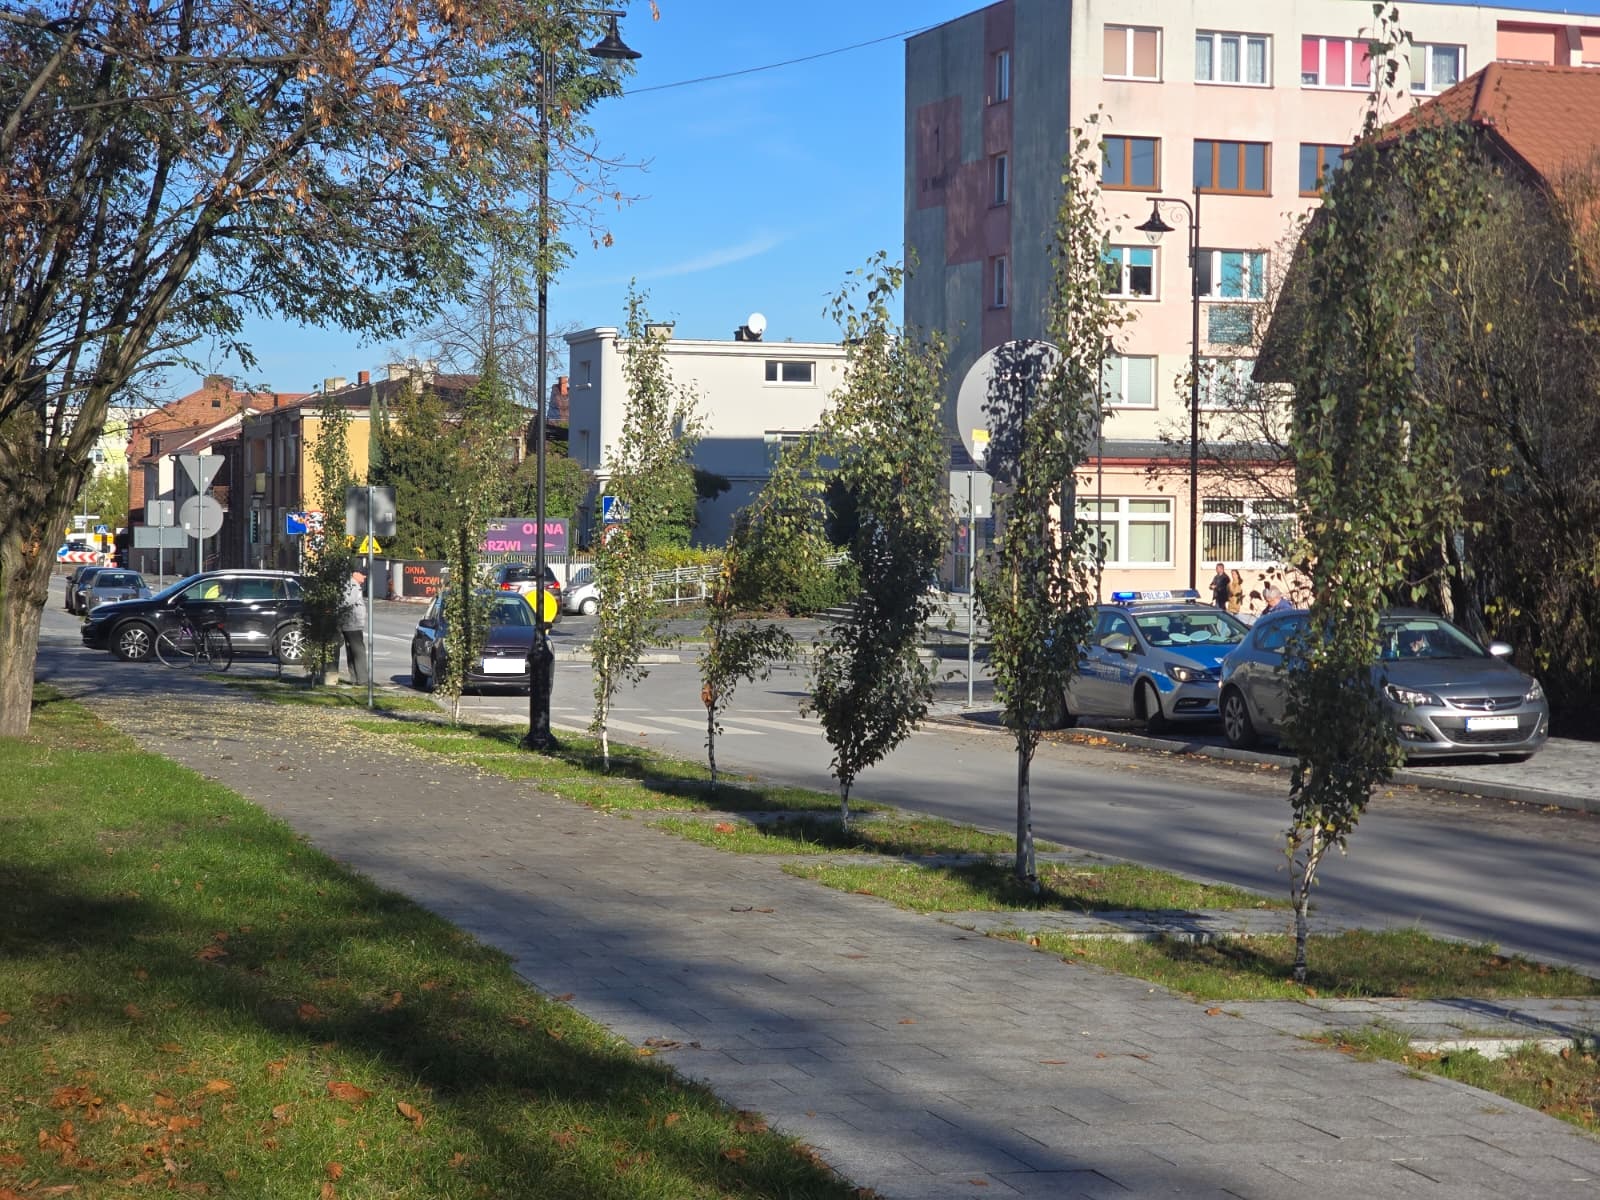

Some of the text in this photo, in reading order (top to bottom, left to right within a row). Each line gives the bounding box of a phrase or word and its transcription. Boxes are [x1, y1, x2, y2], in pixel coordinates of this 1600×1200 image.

[522, 522, 564, 535] ONA
[404, 566, 426, 575] OKNA
[413, 576, 440, 585] DRZWI
[1142, 591, 1171, 600] POLICJA
